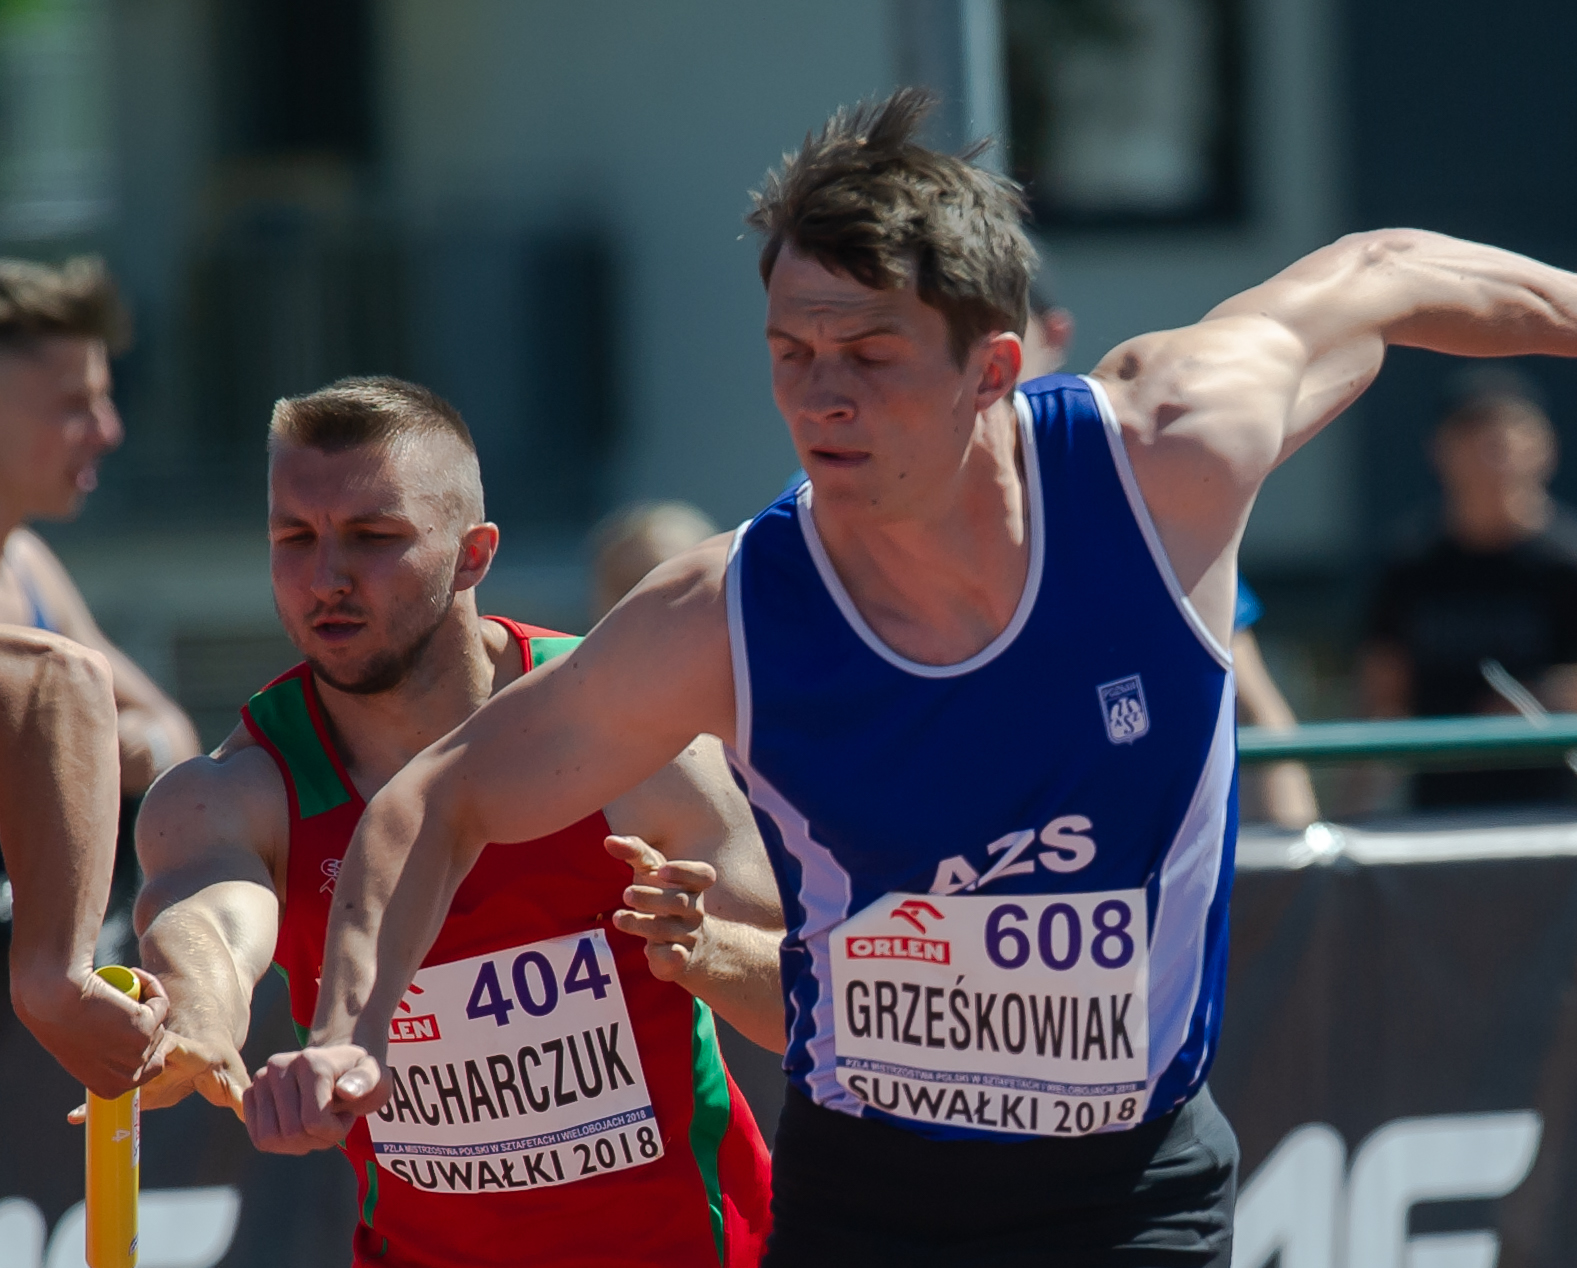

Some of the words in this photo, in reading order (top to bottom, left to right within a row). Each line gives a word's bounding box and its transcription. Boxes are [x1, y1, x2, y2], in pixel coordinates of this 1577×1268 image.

[928, 814, 1096, 896] AZS
[850, 939, 946, 964] ORLEN
[984, 900, 1135, 971] 608
[465, 938, 611, 1027] 404
[388, 1018, 435, 1041] LEN
[845, 974, 1134, 1061] GRZEŚKOWIAK
[560, 1116, 625, 1141] WIELOBOJACH
[626, 1109, 647, 1123] 2018
[848, 1075, 1038, 1130] SUWAŁKI
[1053, 1097, 1137, 1134] 2018
[390, 1150, 565, 1190] SUWAŁKI
[572, 1126, 659, 1176] 2018
